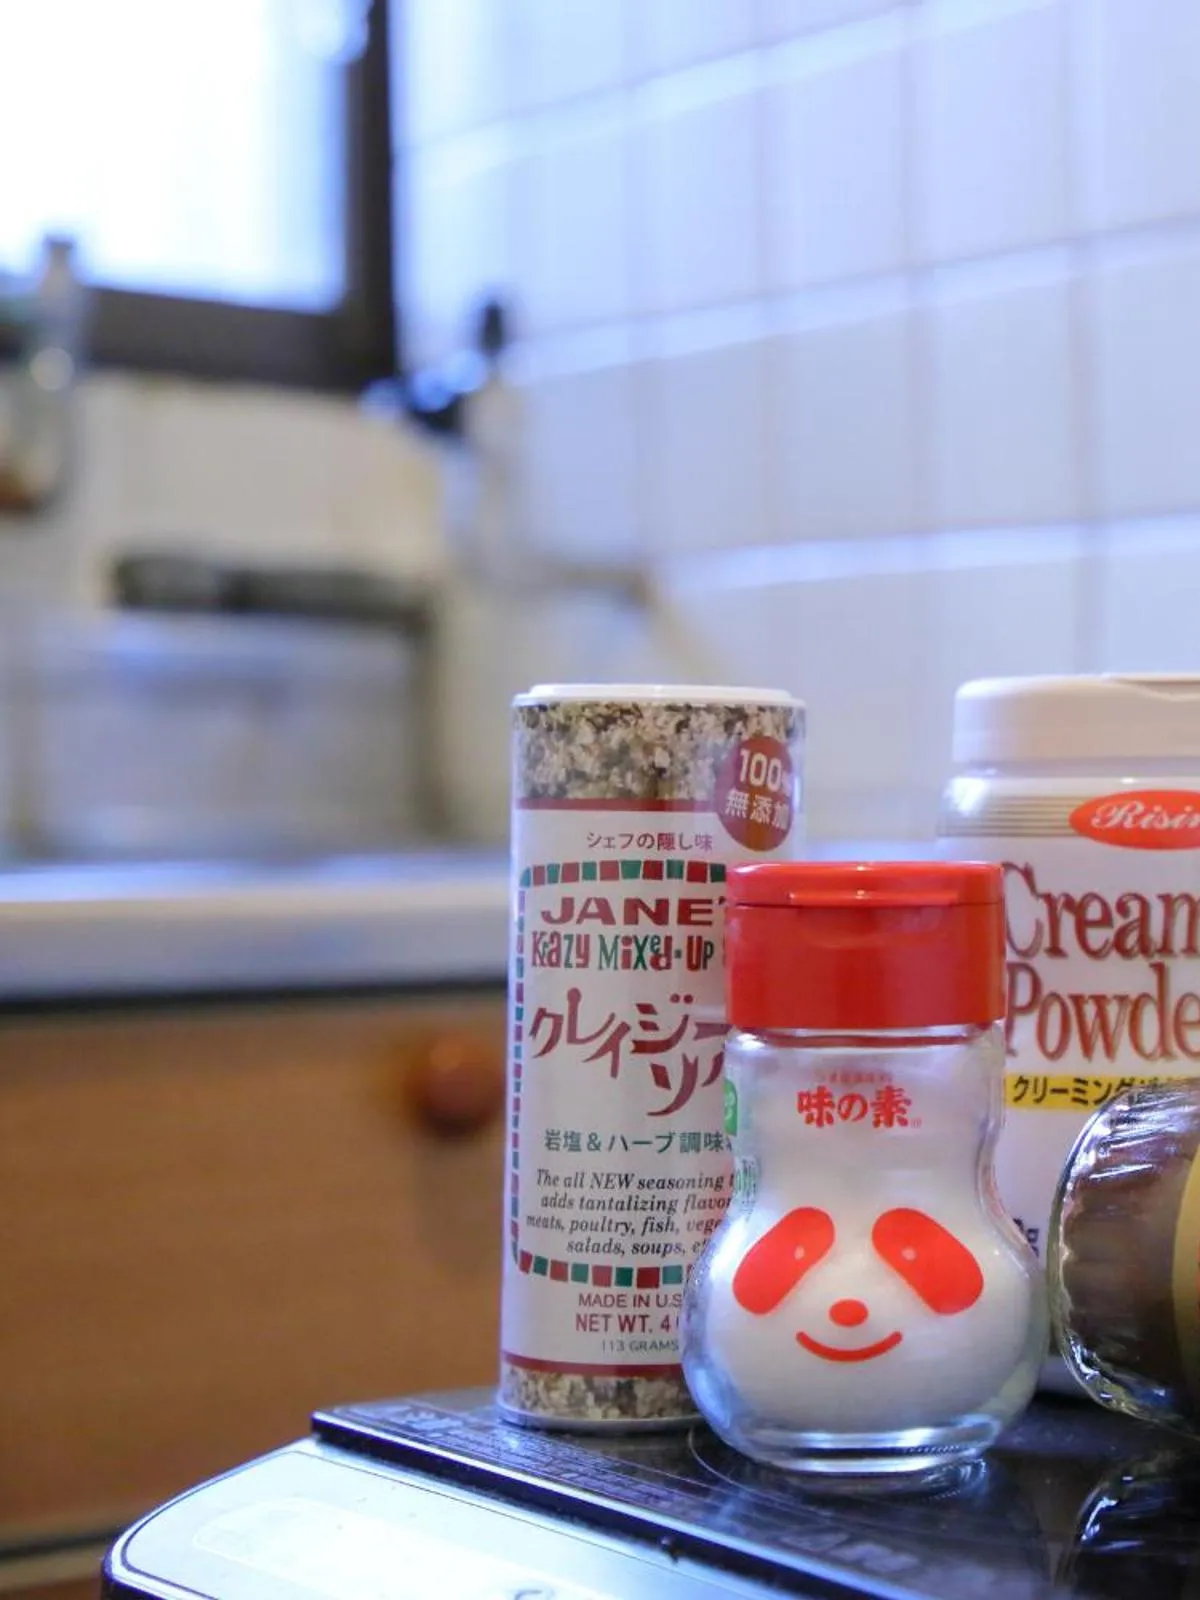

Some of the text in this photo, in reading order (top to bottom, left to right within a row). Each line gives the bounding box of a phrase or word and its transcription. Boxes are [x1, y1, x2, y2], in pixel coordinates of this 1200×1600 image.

[586, 832, 713, 852] シェフの隠し味
[796, 1085, 912, 1129] 味の素
[536, 1168, 560, 1188] The
[563, 1171, 585, 1189] all
[590, 1172, 635, 1190] NEW
[636, 1173, 724, 1192] seasoning
[540, 1192, 575, 1211] adds
[578, 1195, 679, 1215] tantalizing
[568, 1216, 636, 1237] poultry,
[641, 1216, 680, 1237] fish,
[567, 1236, 625, 1257] salads,
[631, 1241, 686, 1259] soups,
[578, 1293, 628, 1309] MADE
[632, 1294, 651, 1309] IN
[575, 1313, 611, 1333] NET
[618, 1314, 653, 1334] WT.
[660, 1314, 671, 1333] 4
[628, 1340, 679, 1352] GRAMS
